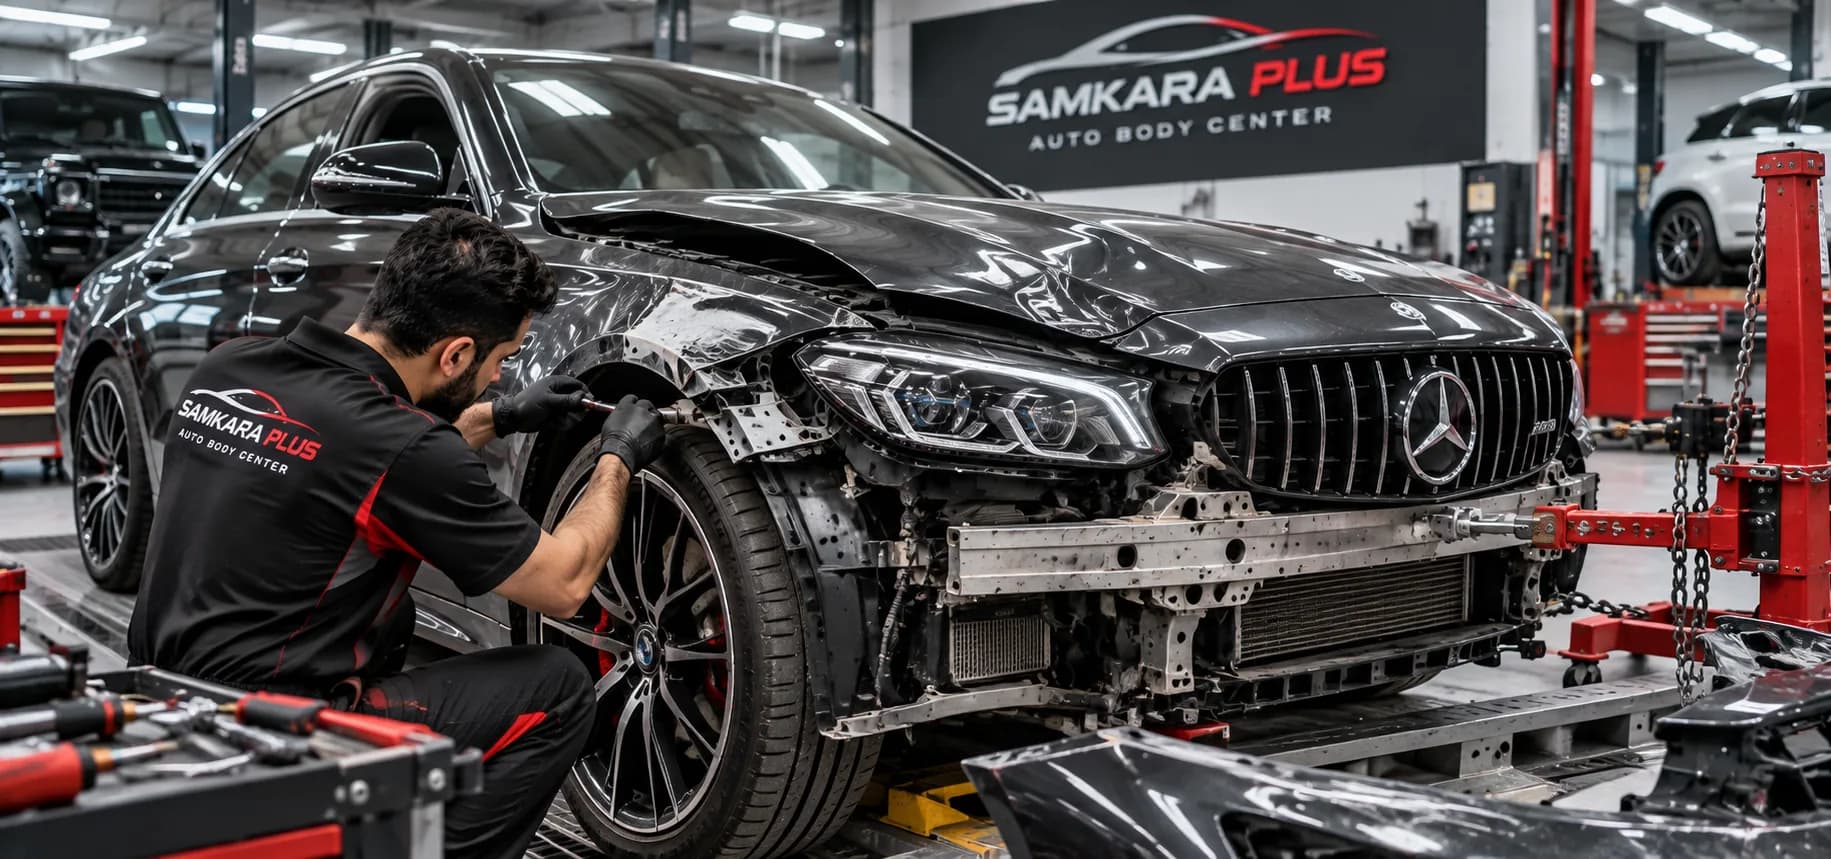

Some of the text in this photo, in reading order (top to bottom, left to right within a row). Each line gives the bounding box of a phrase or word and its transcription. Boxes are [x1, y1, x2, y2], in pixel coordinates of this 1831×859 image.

[986, 47, 1387, 126] SAMKARA PLUS
[1029, 106, 1332, 151] AUTO BODY CENTER
[178, 400, 322, 461] SAMKARA PLUS
[178, 428, 289, 475] AUTO BODY CENTER
